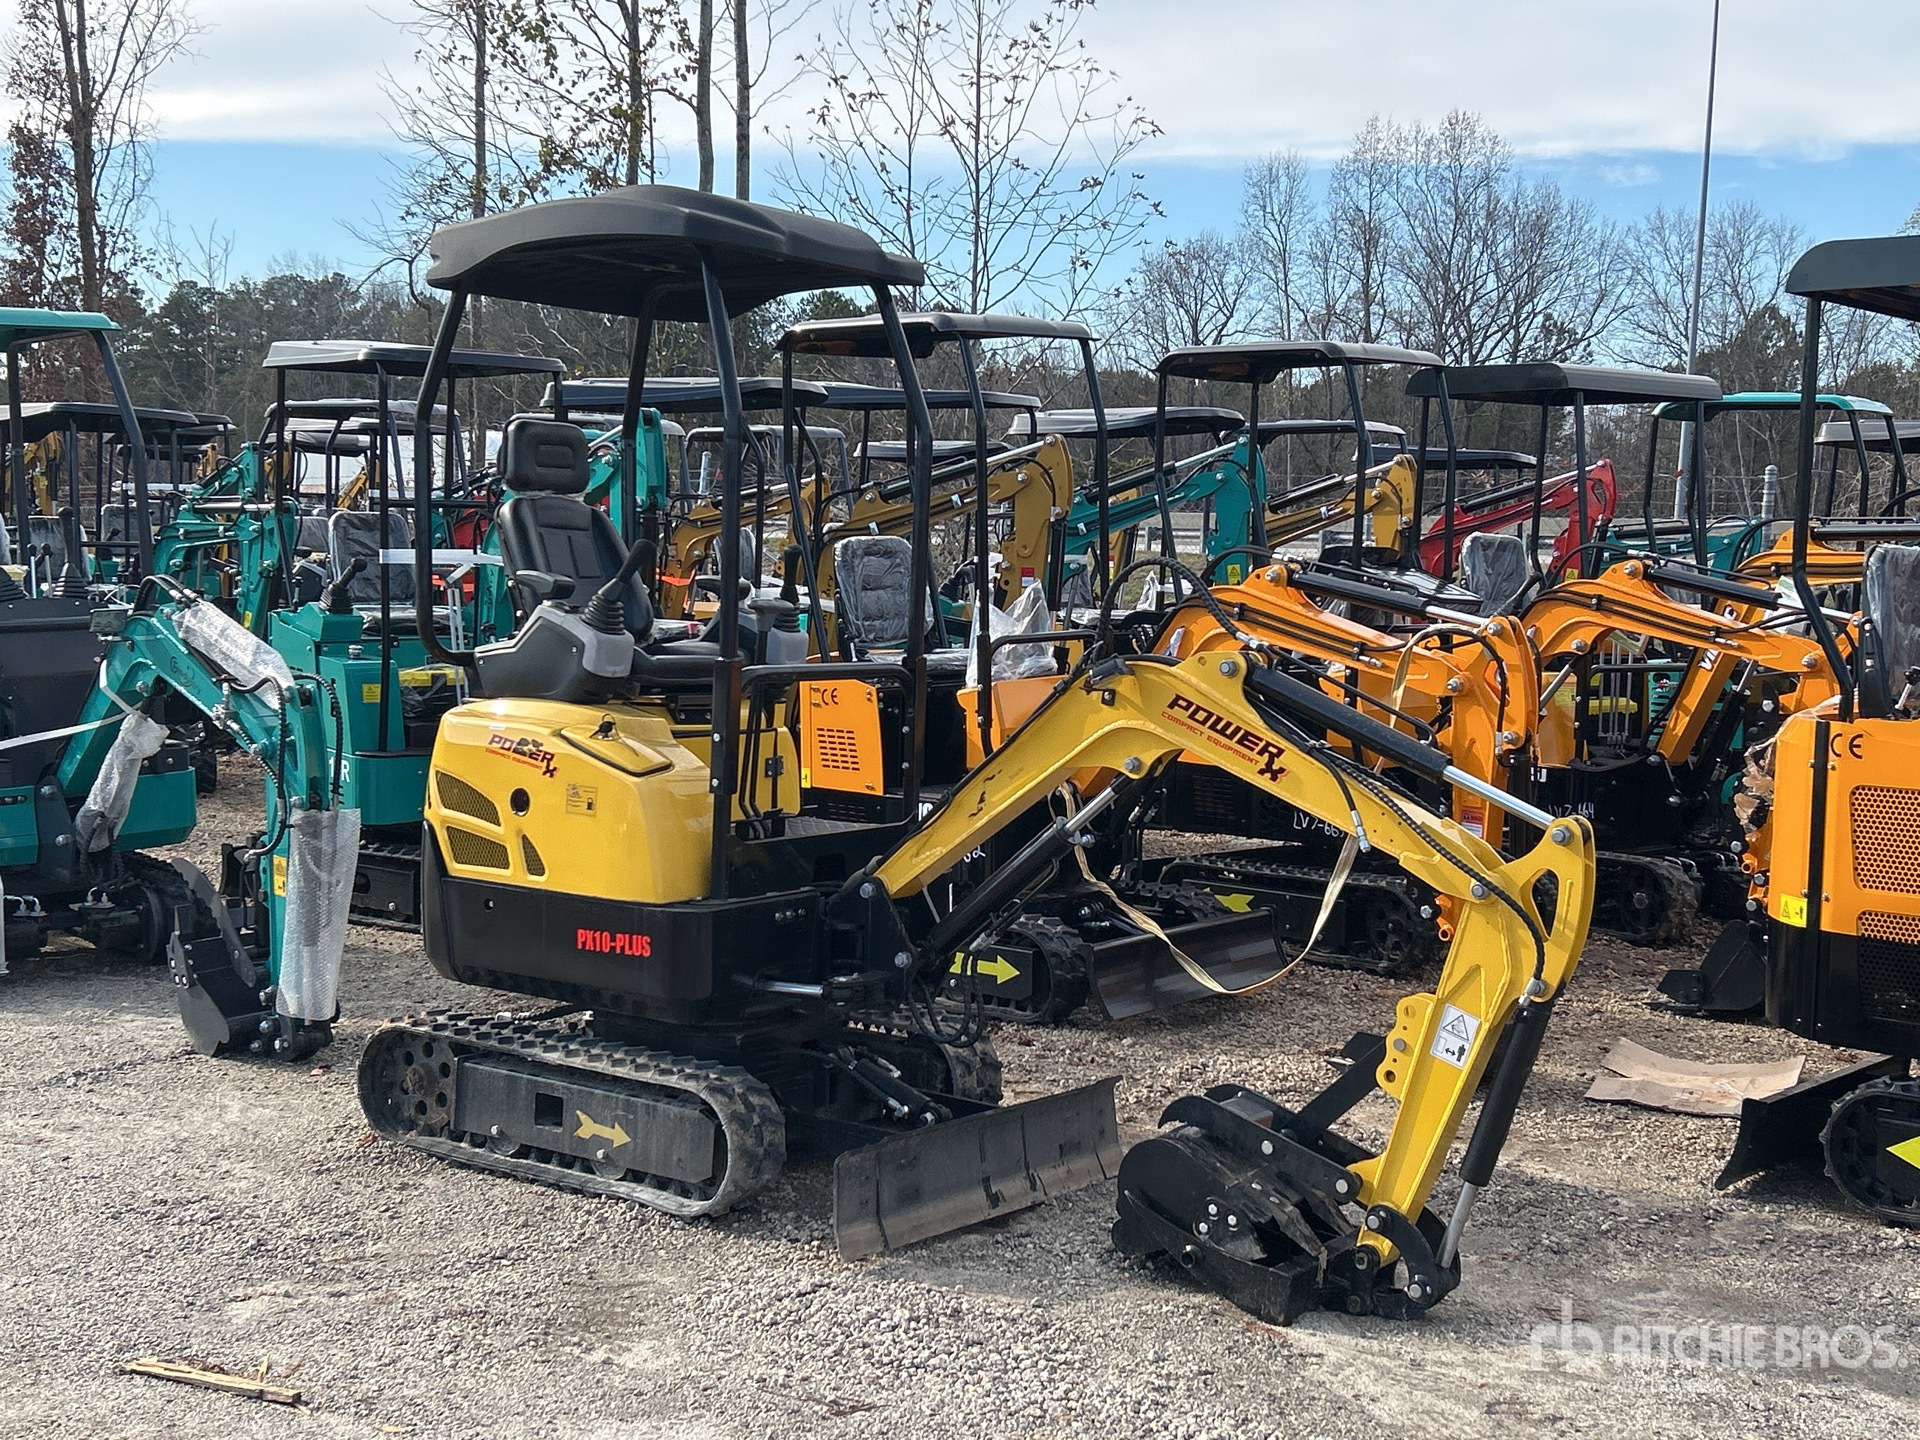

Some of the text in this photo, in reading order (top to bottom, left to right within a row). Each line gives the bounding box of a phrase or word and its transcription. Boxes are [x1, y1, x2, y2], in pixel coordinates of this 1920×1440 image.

[1161, 711, 1260, 766] COMPACT EQUIPMENT
[576, 928, 652, 958] PX10-PLUS
